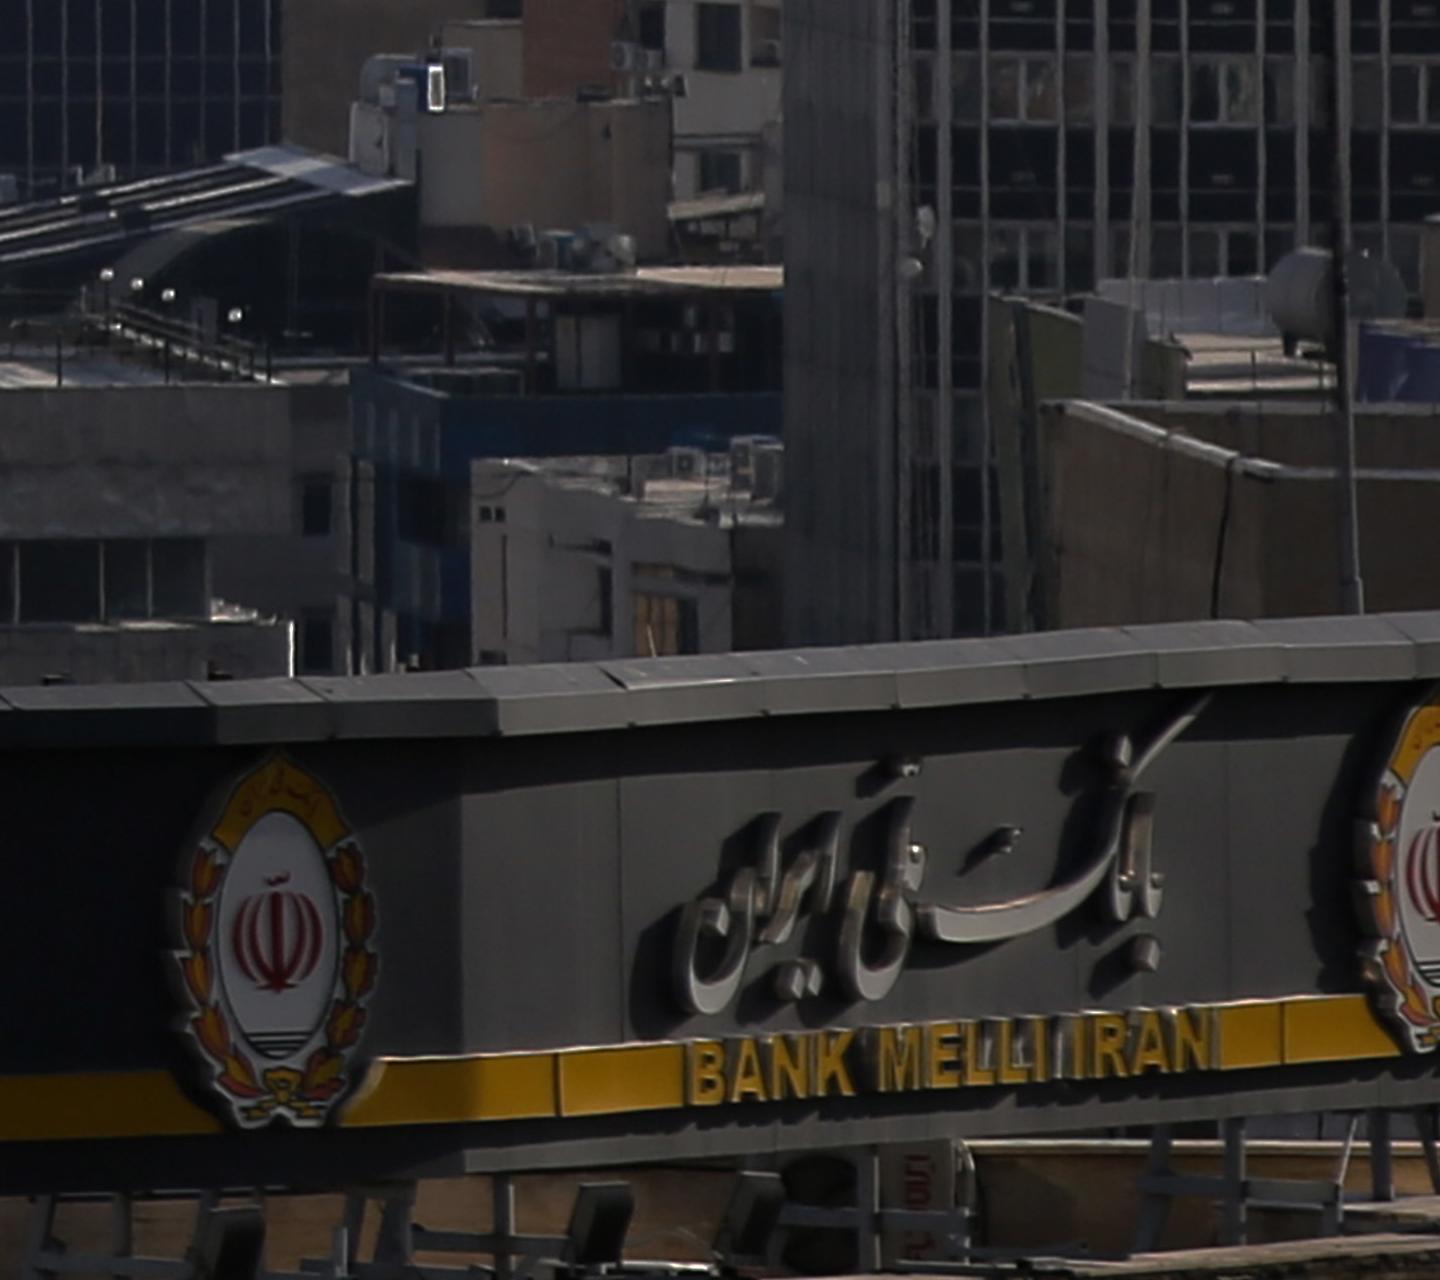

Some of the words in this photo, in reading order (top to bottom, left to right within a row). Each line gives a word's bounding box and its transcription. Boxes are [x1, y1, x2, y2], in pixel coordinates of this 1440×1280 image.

[674, 810, 842, 1014] ایران
[688, 1027, 857, 1105] BANK
[877, 1016, 1046, 1092] MELLI
[1067, 1007, 1210, 1078] IRAN
